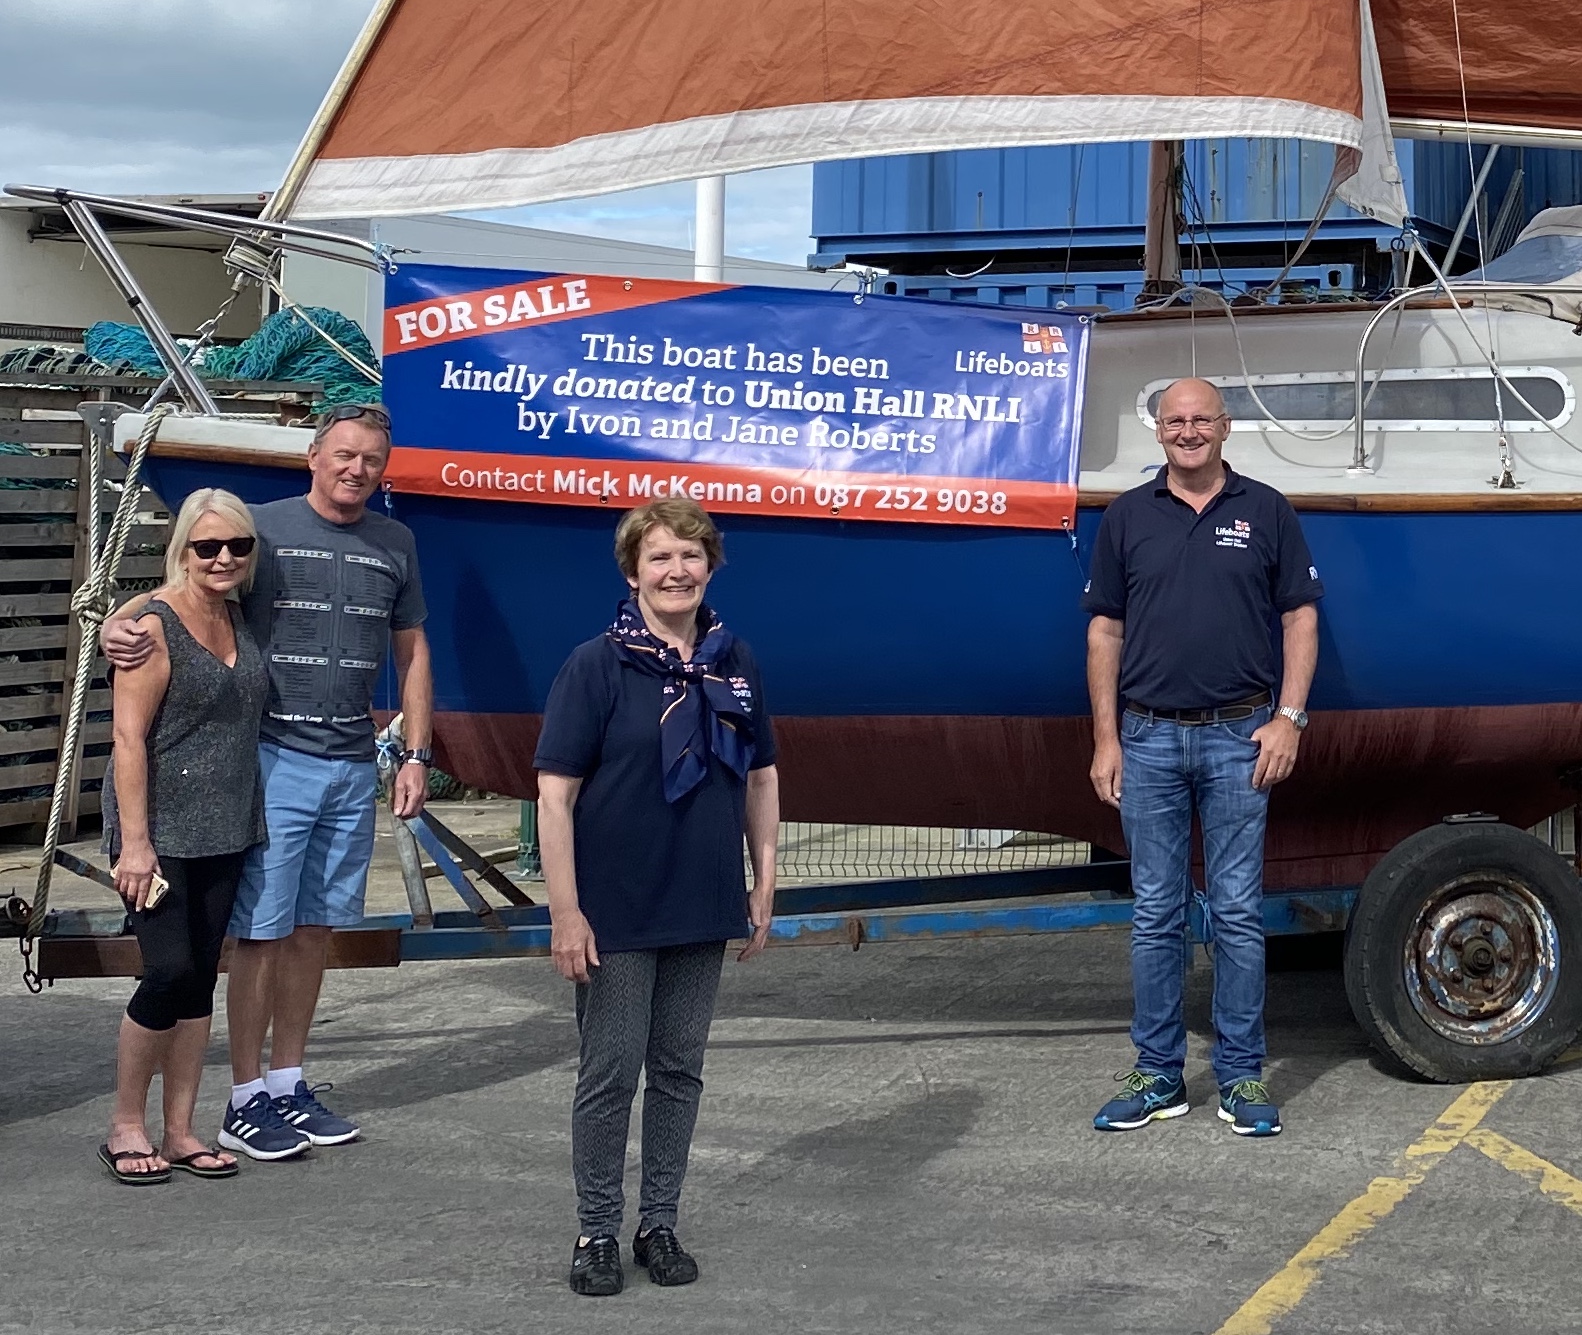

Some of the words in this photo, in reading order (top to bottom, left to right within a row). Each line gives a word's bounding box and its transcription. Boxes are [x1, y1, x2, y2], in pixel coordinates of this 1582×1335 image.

[394, 300, 478, 345] FOR
[483, 279, 591, 326] SALE
[580, 333, 655, 365] This
[662, 337, 737, 370] boat
[744, 343, 803, 375] has
[811, 347, 890, 380] been
[955, 350, 1069, 378] Lifeboats
[440, 360, 547, 401] kindly
[552, 368, 696, 404] donated
[702, 380, 735, 407] to
[744, 381, 846, 413] Union
[851, 387, 925, 418] Hall
[930, 392, 1022, 423] RNLI
[517, 402, 558, 440] by
[564, 406, 641, 437] Ivon
[650, 414, 713, 441] and
[721, 416, 799, 446] Jane
[806, 420, 936, 453] Roberts
[441, 462, 546, 493] Contact
[553, 468, 620, 497] Mick
[628, 473, 762, 503] McKenna
[770, 484, 805, 506] on
[814, 483, 869, 508] 087
[874, 485, 928, 511] 252
[936, 489, 1007, 514] 9038
